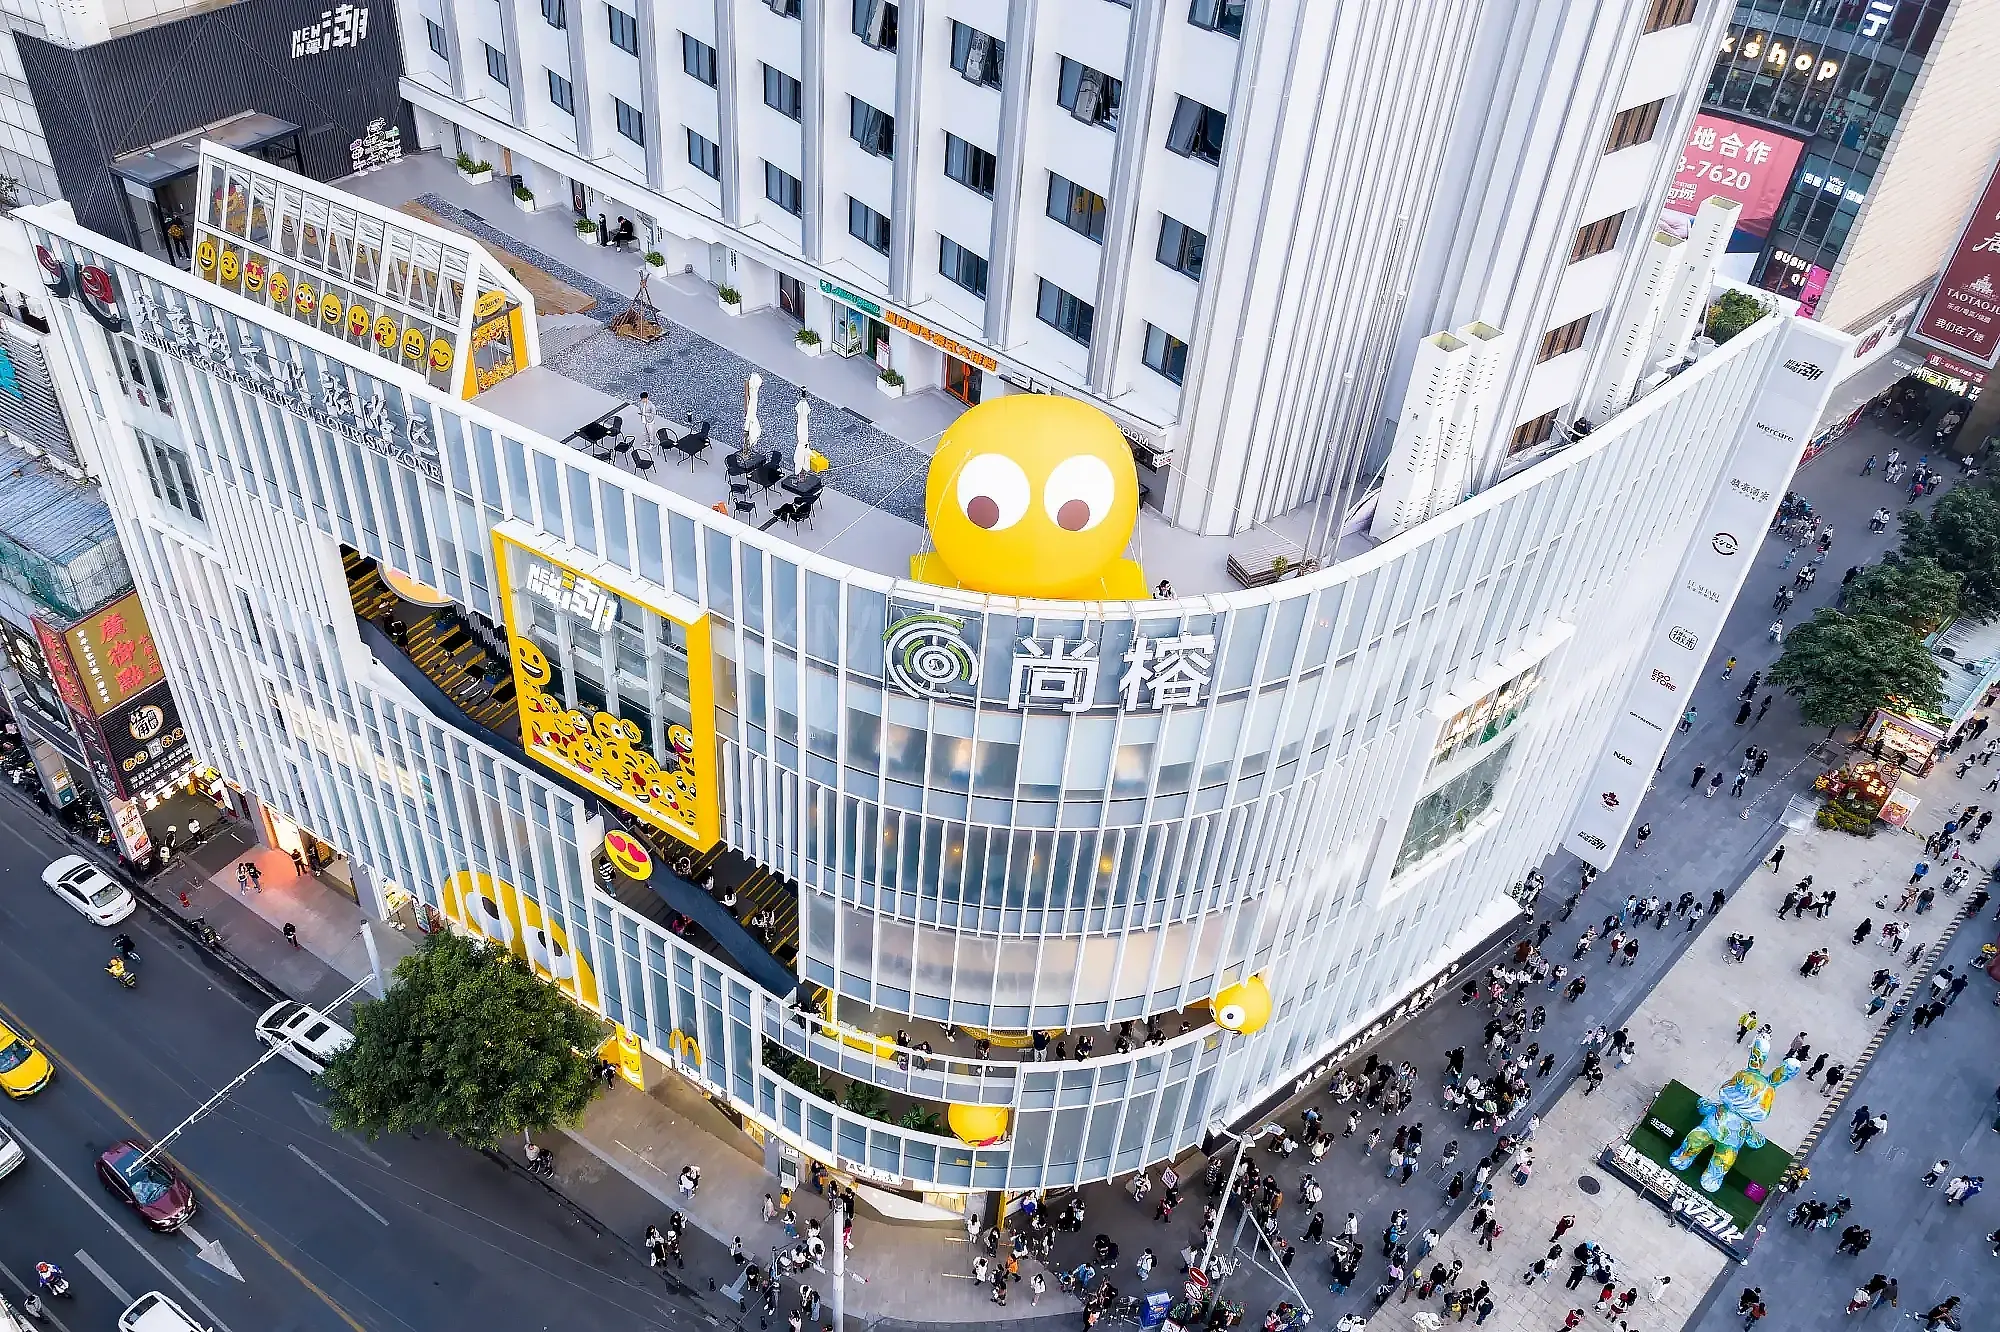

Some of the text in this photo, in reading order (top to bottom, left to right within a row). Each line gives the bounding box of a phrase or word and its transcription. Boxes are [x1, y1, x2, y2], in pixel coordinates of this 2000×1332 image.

[1690, 126, 1773, 165] 地合作
[1774, 250, 1812, 273] SUSHI
[1756, 421, 1794, 443] Mercure
[1007, 631, 1215, 713] 尚榕
[1650, 674, 1677, 692] STORE
[1652, 668, 1671, 682] EGO
[1613, 750, 1633, 766] NAG
